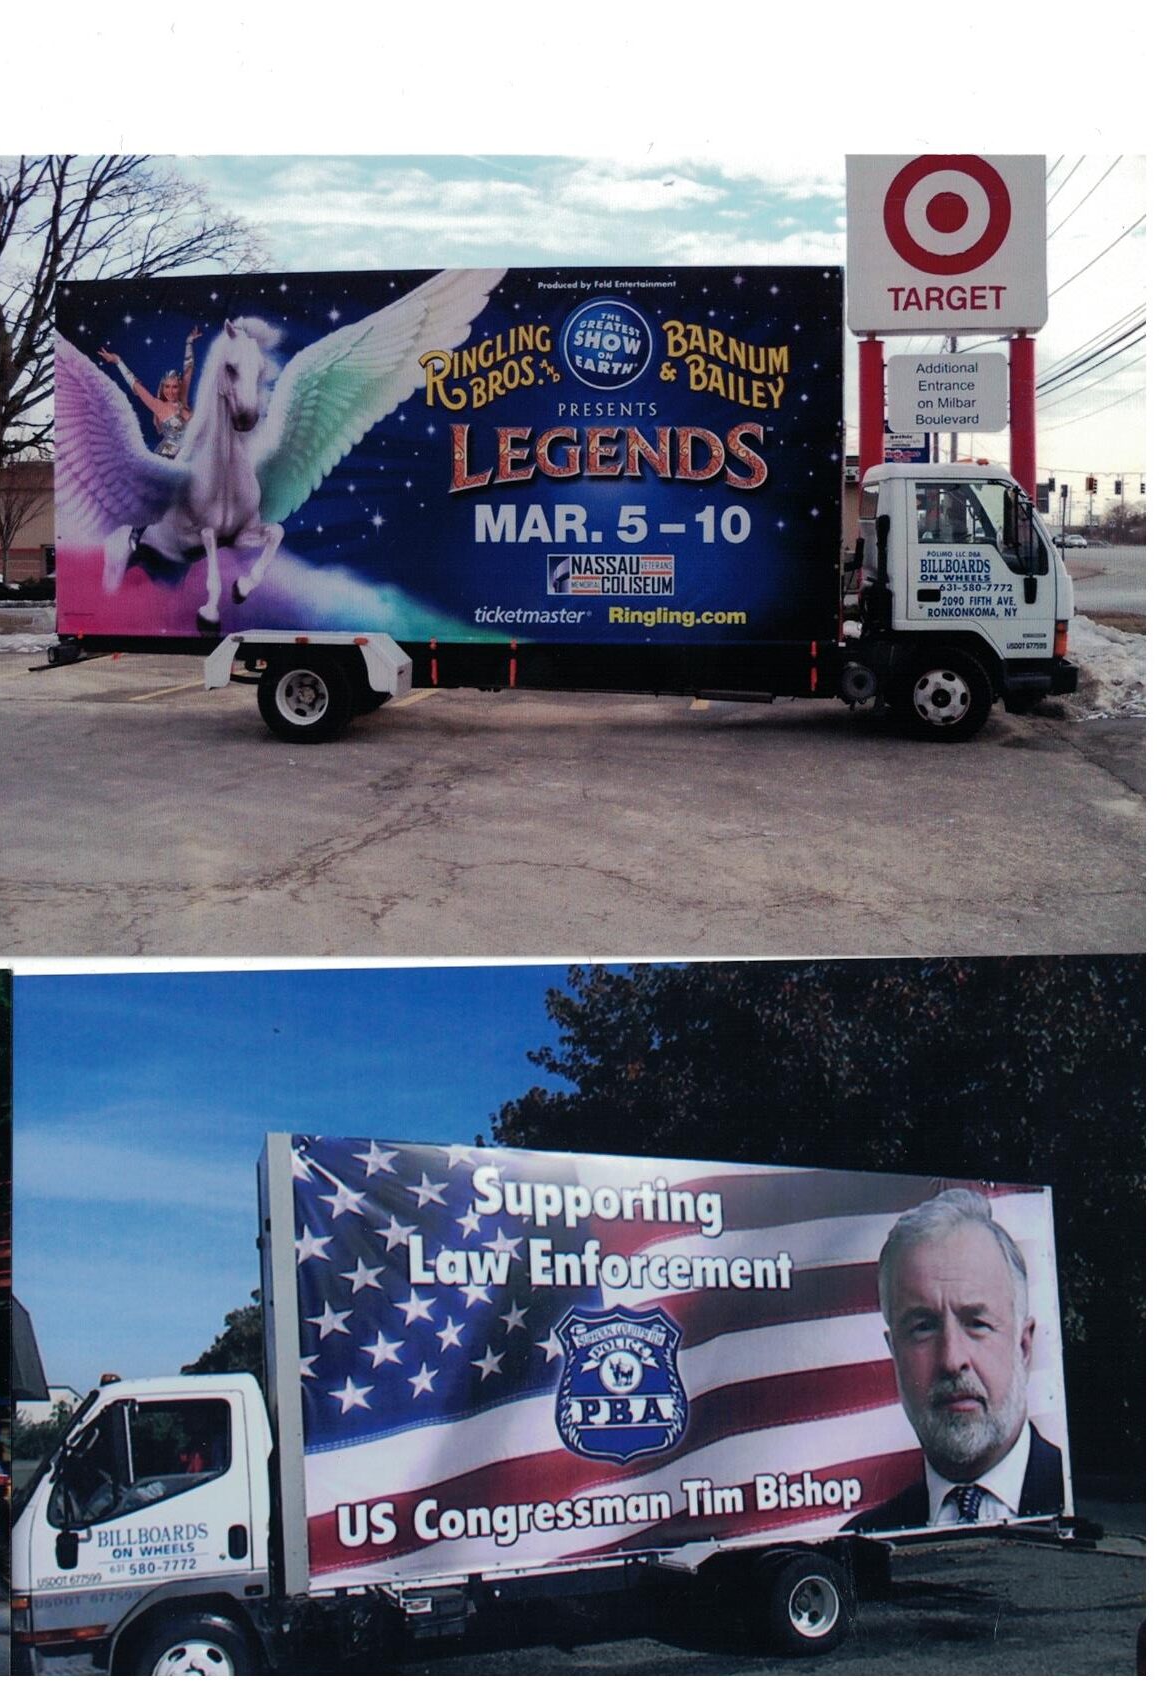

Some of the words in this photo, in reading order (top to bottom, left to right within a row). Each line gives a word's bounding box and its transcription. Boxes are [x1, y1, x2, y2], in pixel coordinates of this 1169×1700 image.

[538, 280, 578, 289] Produced
[581, 280, 591, 290] by
[594, 280, 612, 288] Feld
[615, 280, 676, 288] Entertainment
[887, 286, 1007, 311] TARGET
[600, 313, 621, 321] THE
[579, 320, 640, 338] GREATEST
[573, 330, 642, 355] SHOW
[662, 320, 789, 375] BARNUM
[575, 355, 634, 375] EARTH
[598, 352, 613, 360] ON
[418, 325, 551, 410] RINGLING
[916, 362, 978, 374] Additional
[469, 355, 544, 409] BROS.
[539, 359, 561, 383] AND
[659, 361, 677, 382] &
[684, 354, 785, 409] BAILEY
[918, 380, 975, 391] Entrance
[558, 402, 657, 416] PRESENTS
[917, 400, 933, 408] on
[937, 397, 976, 408] Milbar
[915, 414, 979, 425] Boulevard
[448, 422, 768, 494] LEGENDS
[474, 504, 602, 543] MAR.
[616, 505, 648, 543] 5
[695, 505, 751, 543] 10
[571, 556, 639, 575] NASSAU
[640, 561, 672, 570] VETERANS
[920, 559, 991, 573] BILLBOARDS
[601, 576, 672, 594] COLISEUM
[939, 583, 1012, 592] 631-580-7772
[942, 596, 964, 606] 2090
[969, 596, 991, 606] FIFTH
[997, 596, 1016, 606] AVE.
[474, 606, 585, 624] ticketmaster
[608, 606, 746, 627] Ringling.com
[928, 608, 999, 618] RONKONKOMA,
[1004, 608, 1018, 617] NY
[471, 1166, 724, 1238] Supporting
[407, 1234, 511, 1285] Law
[529, 1238, 793, 1289] Enforcement
[592, 1338, 647, 1357] POLICE
[581, 1398, 671, 1424] PBA
[337, 1502, 396, 1547] US
[414, 1491, 672, 1546] Congressman
[682, 1479, 744, 1517] Tim
[755, 1471, 862, 1511] Bishop
[97, 1523, 209, 1548] BILLBOARDS
[112, 1549, 133, 1559] ON
[140, 1543, 195, 1557] WHEELS
[129, 1558, 197, 1576] 580-7772
[37, 1576, 68, 1588] USDOT
